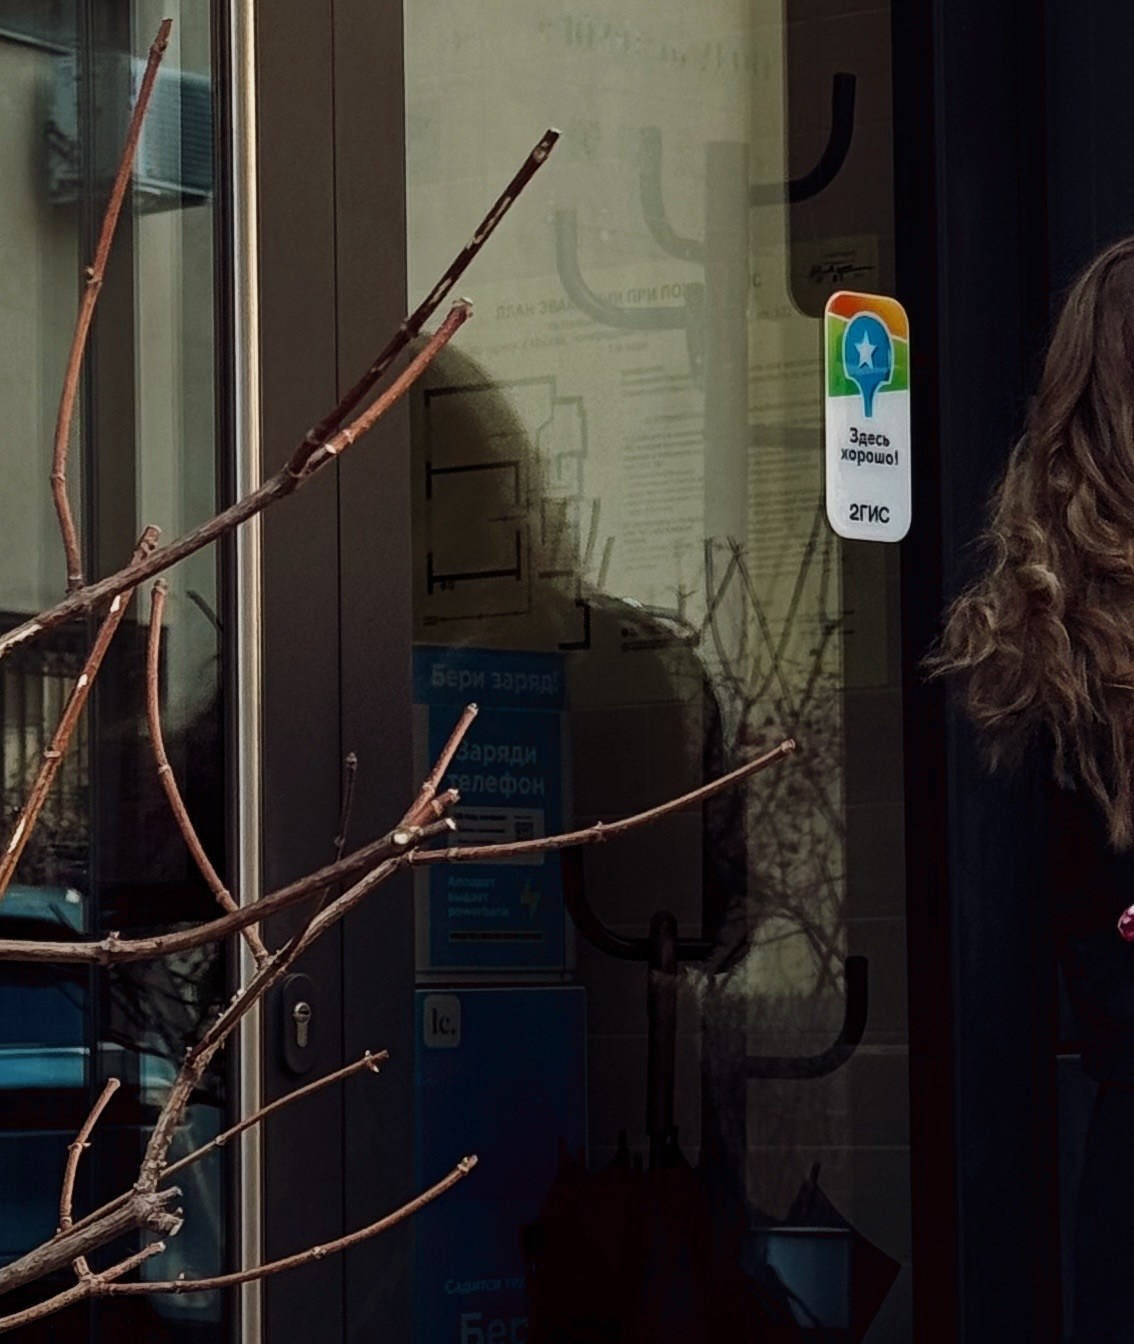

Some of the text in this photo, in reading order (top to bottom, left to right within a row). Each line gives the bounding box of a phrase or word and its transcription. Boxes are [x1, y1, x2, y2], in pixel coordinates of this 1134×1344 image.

[849, 426, 890, 448] Здесь
[841, 447, 899, 467] хорошо!
[849, 503, 890, 524] 2ГИС
[431, 662, 485, 692] Бери
[446, 770, 546, 800] телефон
